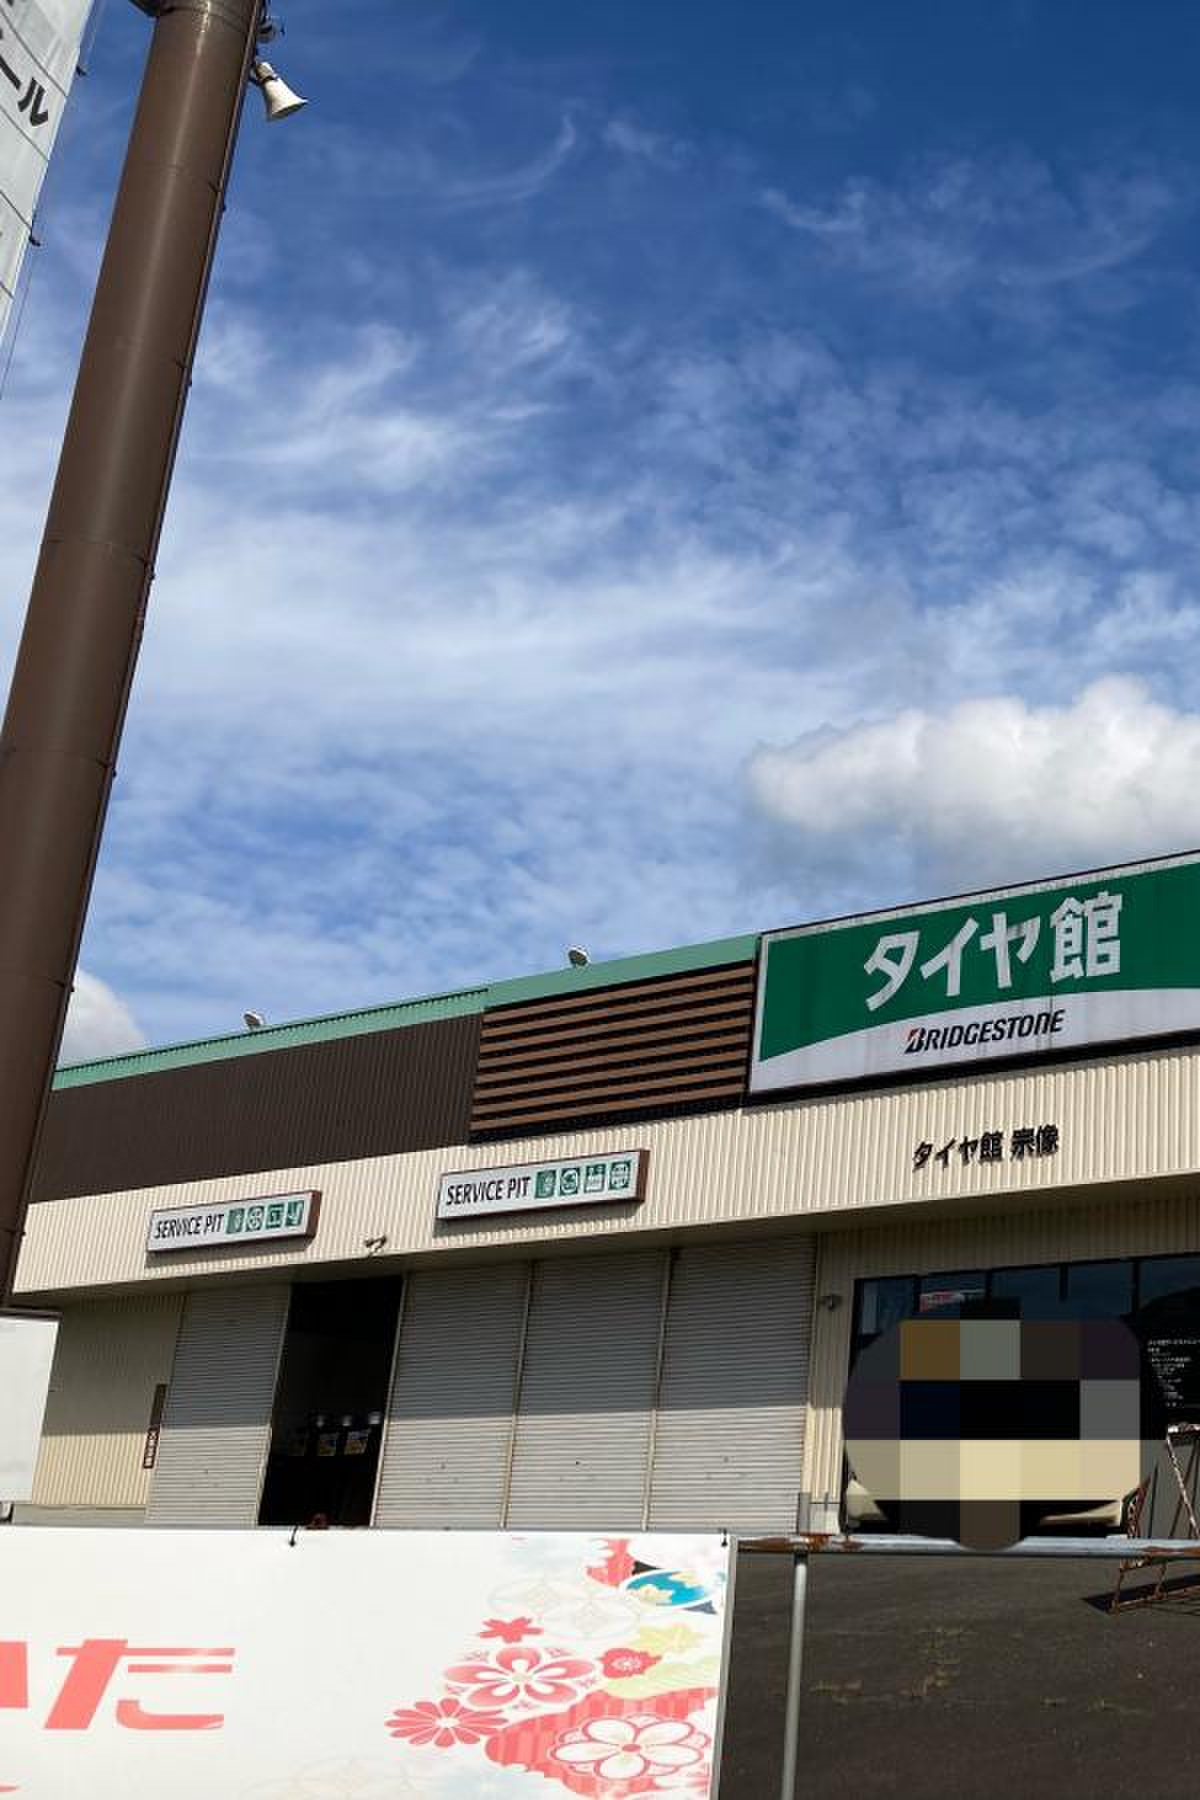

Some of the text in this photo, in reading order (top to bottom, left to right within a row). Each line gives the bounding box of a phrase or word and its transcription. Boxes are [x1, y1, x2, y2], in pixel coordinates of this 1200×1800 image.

[863, 890, 1123, 1012] タイヤ館
[905, 1009, 1065, 1055] BRIDGESTONE
[912, 1130, 1004, 1172] タイヤ館
[446, 1176, 531, 1206] SERVICE PIT
[153, 1213, 225, 1240] SERVICE PIT
